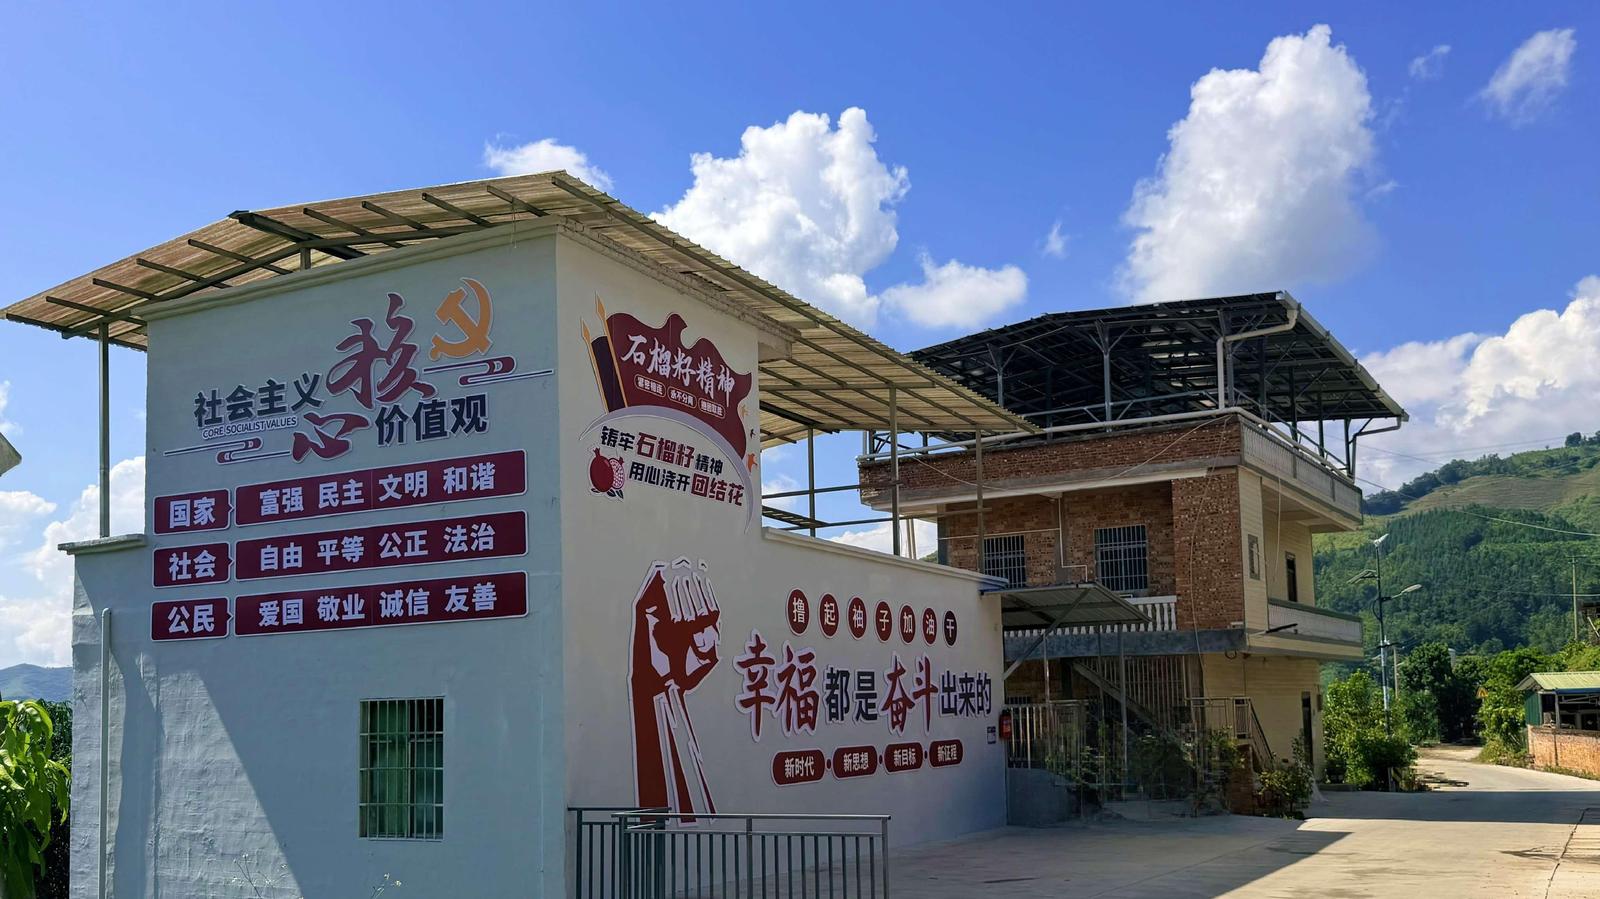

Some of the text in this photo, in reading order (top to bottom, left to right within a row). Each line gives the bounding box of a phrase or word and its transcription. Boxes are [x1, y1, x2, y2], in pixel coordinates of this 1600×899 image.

[621, 334, 735, 407] 石榴籽精神
[193, 373, 324, 427] 社会主义
[375, 394, 487, 446] 价值观
[202, 426, 224, 438] CORE
[259, 462, 496, 516] 富强 民主 文明 和谐
[629, 461, 744, 506] 用心浇开团结花
[169, 497, 216, 528] 国家
[168, 550, 216, 581] 社会
[259, 523, 496, 571] 自由 平等 公正 法治
[167, 605, 215, 634] 公民
[258, 582, 497, 628] 爱国 敬业 诚信 友善
[792, 597, 955, 638] 撸起袖子加油干
[737, 634, 992, 737] 幸福都是奋斗出来的
[784, 744, 958, 778] 新时代 新思想 新目标 新征程
